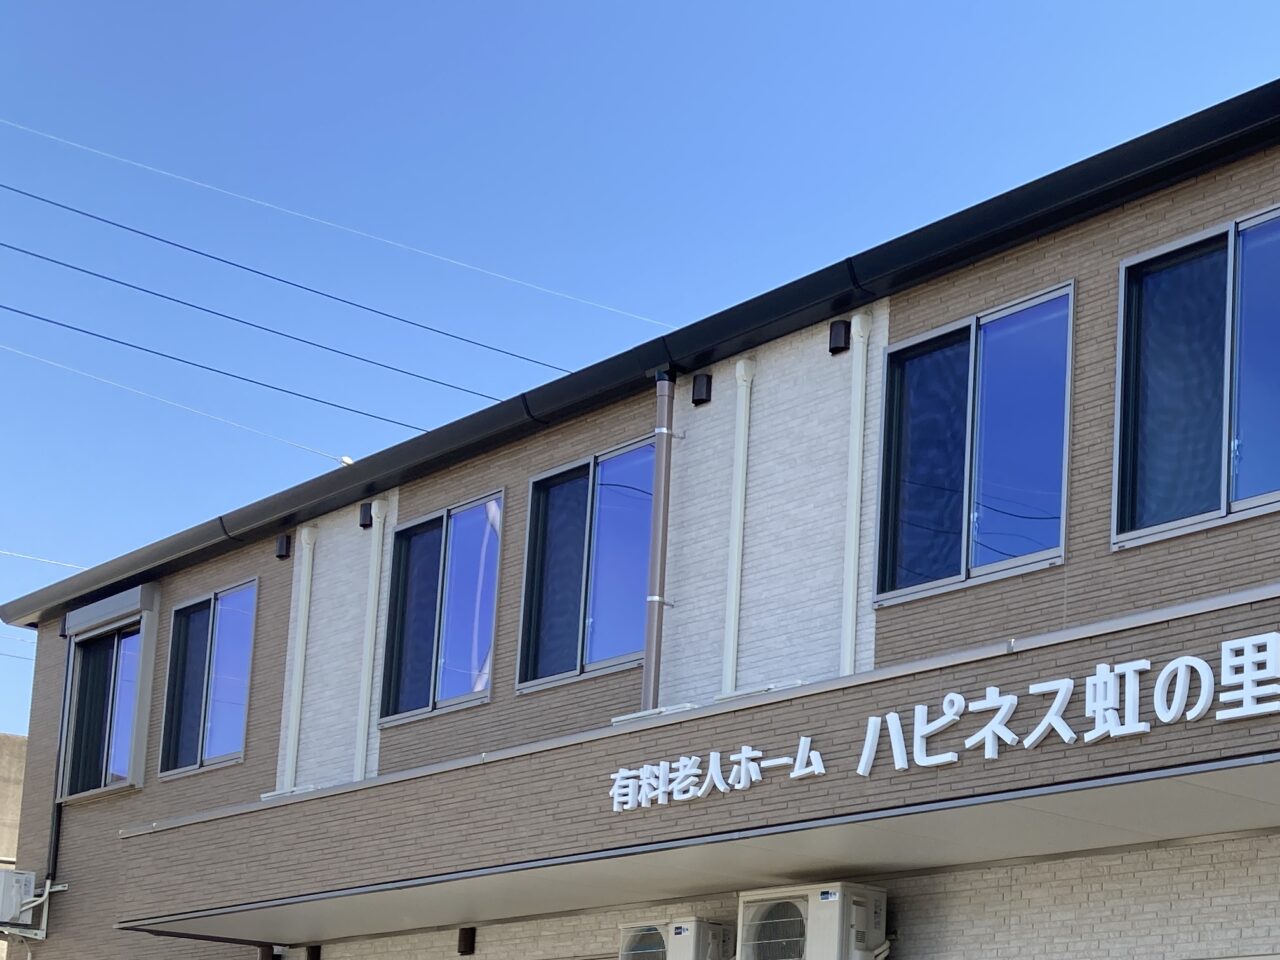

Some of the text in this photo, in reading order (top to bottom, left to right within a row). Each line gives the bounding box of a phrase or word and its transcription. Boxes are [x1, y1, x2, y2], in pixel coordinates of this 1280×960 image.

[609, 736, 826, 812] 有料老人ホーム
